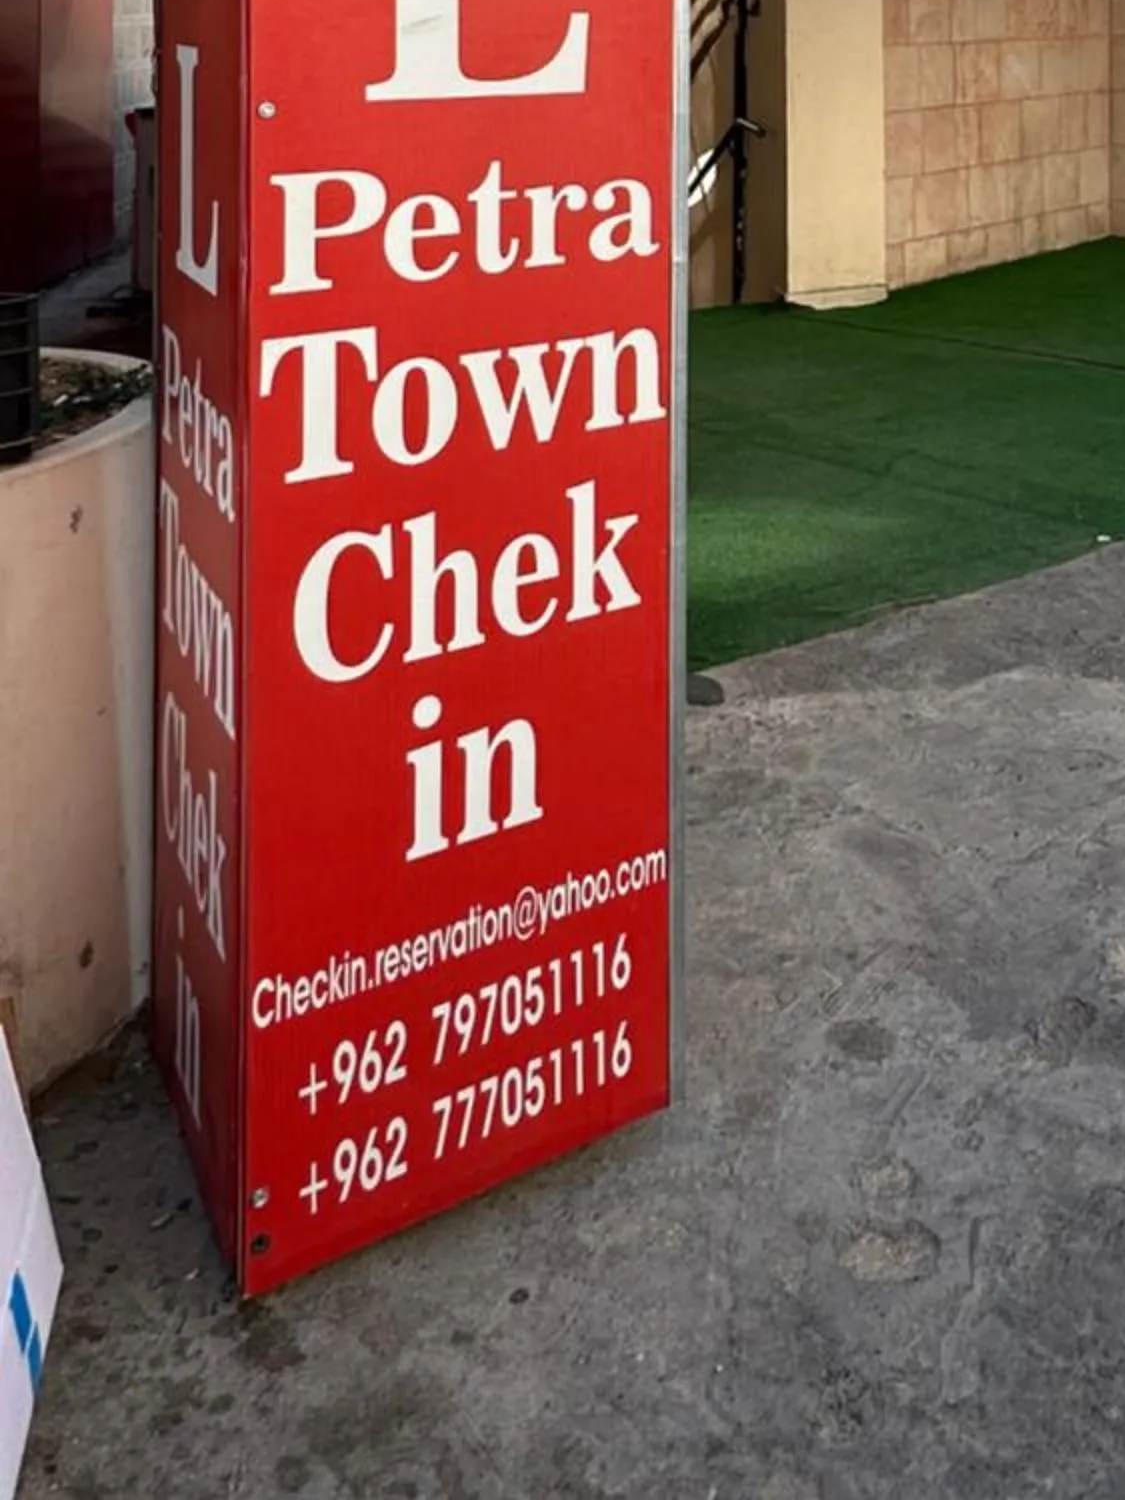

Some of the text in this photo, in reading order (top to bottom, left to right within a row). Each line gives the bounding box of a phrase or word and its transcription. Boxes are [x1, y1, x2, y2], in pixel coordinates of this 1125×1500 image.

[269, 160, 661, 296] Petra
[161, 323, 236, 524] Petra
[259, 326, 666, 485] Town
[160, 477, 236, 741] Town
[293, 479, 642, 684] Chek
[162, 691, 226, 963] Chek
[405, 694, 543, 863] in
[174, 904, 202, 1131] in
[252, 847, 667, 1029] Checkin.reservation@yahoo.com
[298, 932, 633, 1116] +962 797051116
[298, 1020, 633, 1215] +962 777051116
